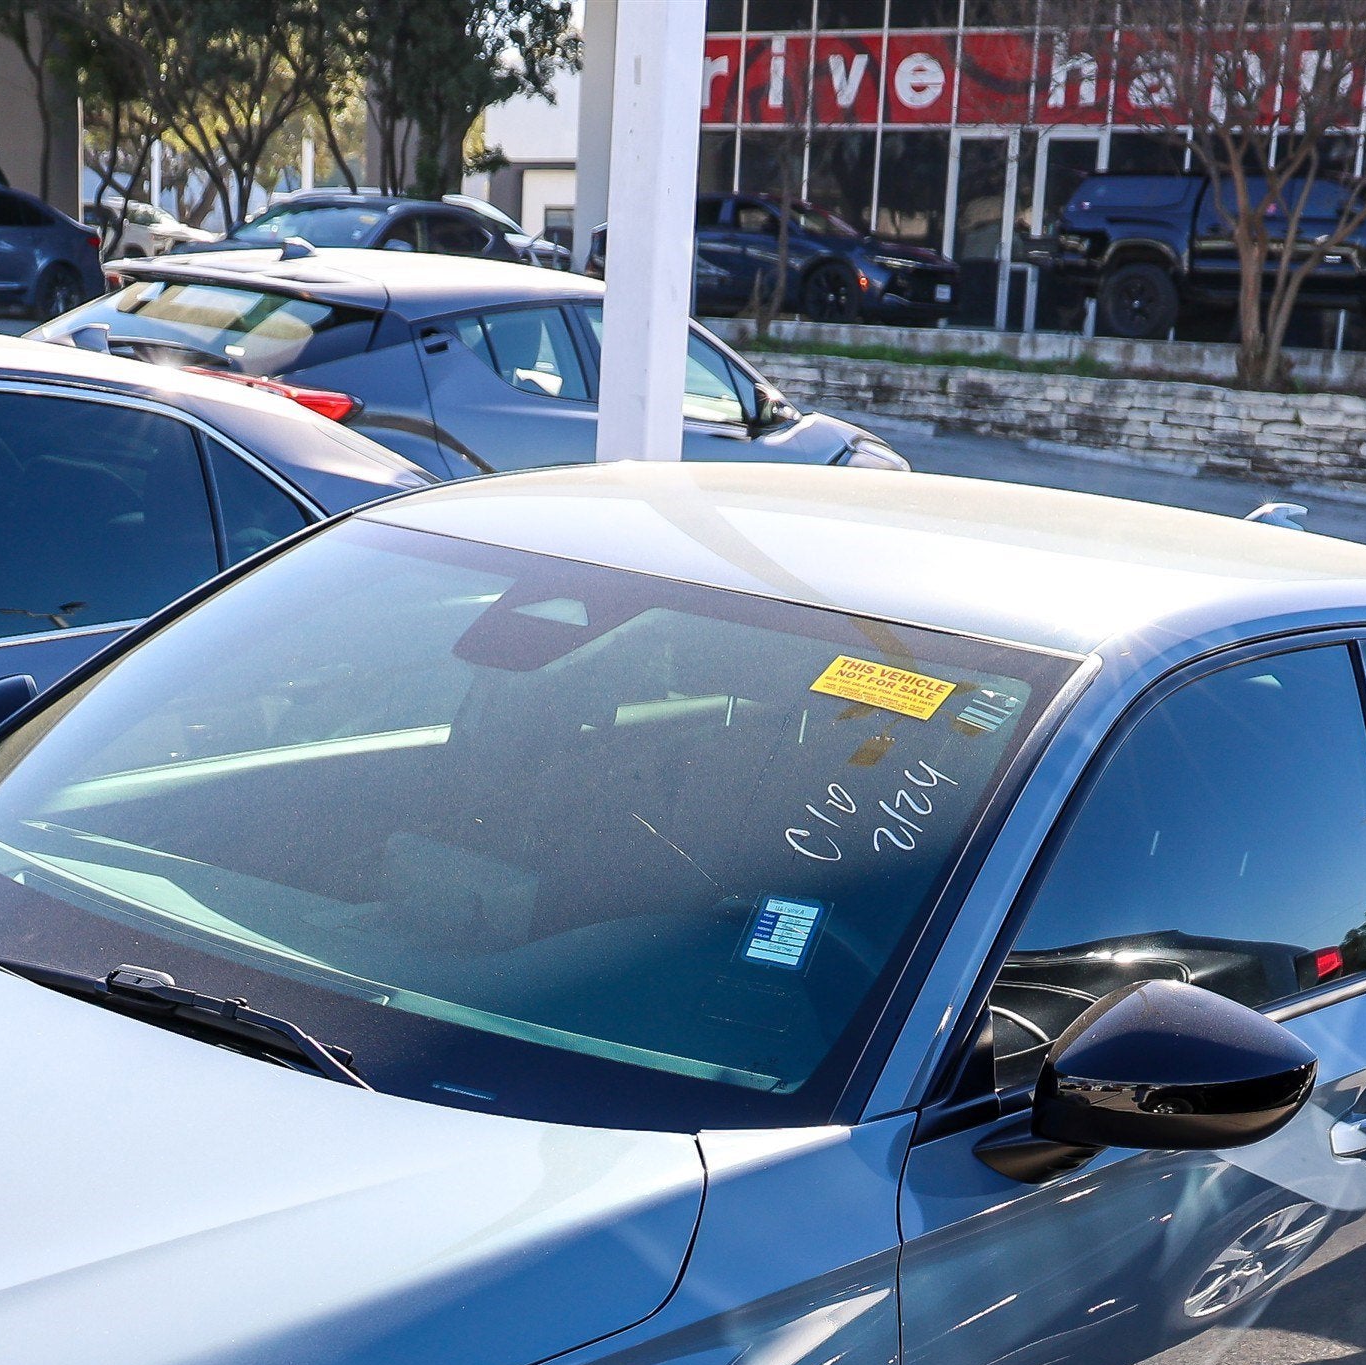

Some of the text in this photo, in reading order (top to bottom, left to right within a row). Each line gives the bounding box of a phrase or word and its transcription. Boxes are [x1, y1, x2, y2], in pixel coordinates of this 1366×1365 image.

[835, 669, 938, 700] NOT FOR SALE
[839, 659, 949, 694] THIS VEHICLE
